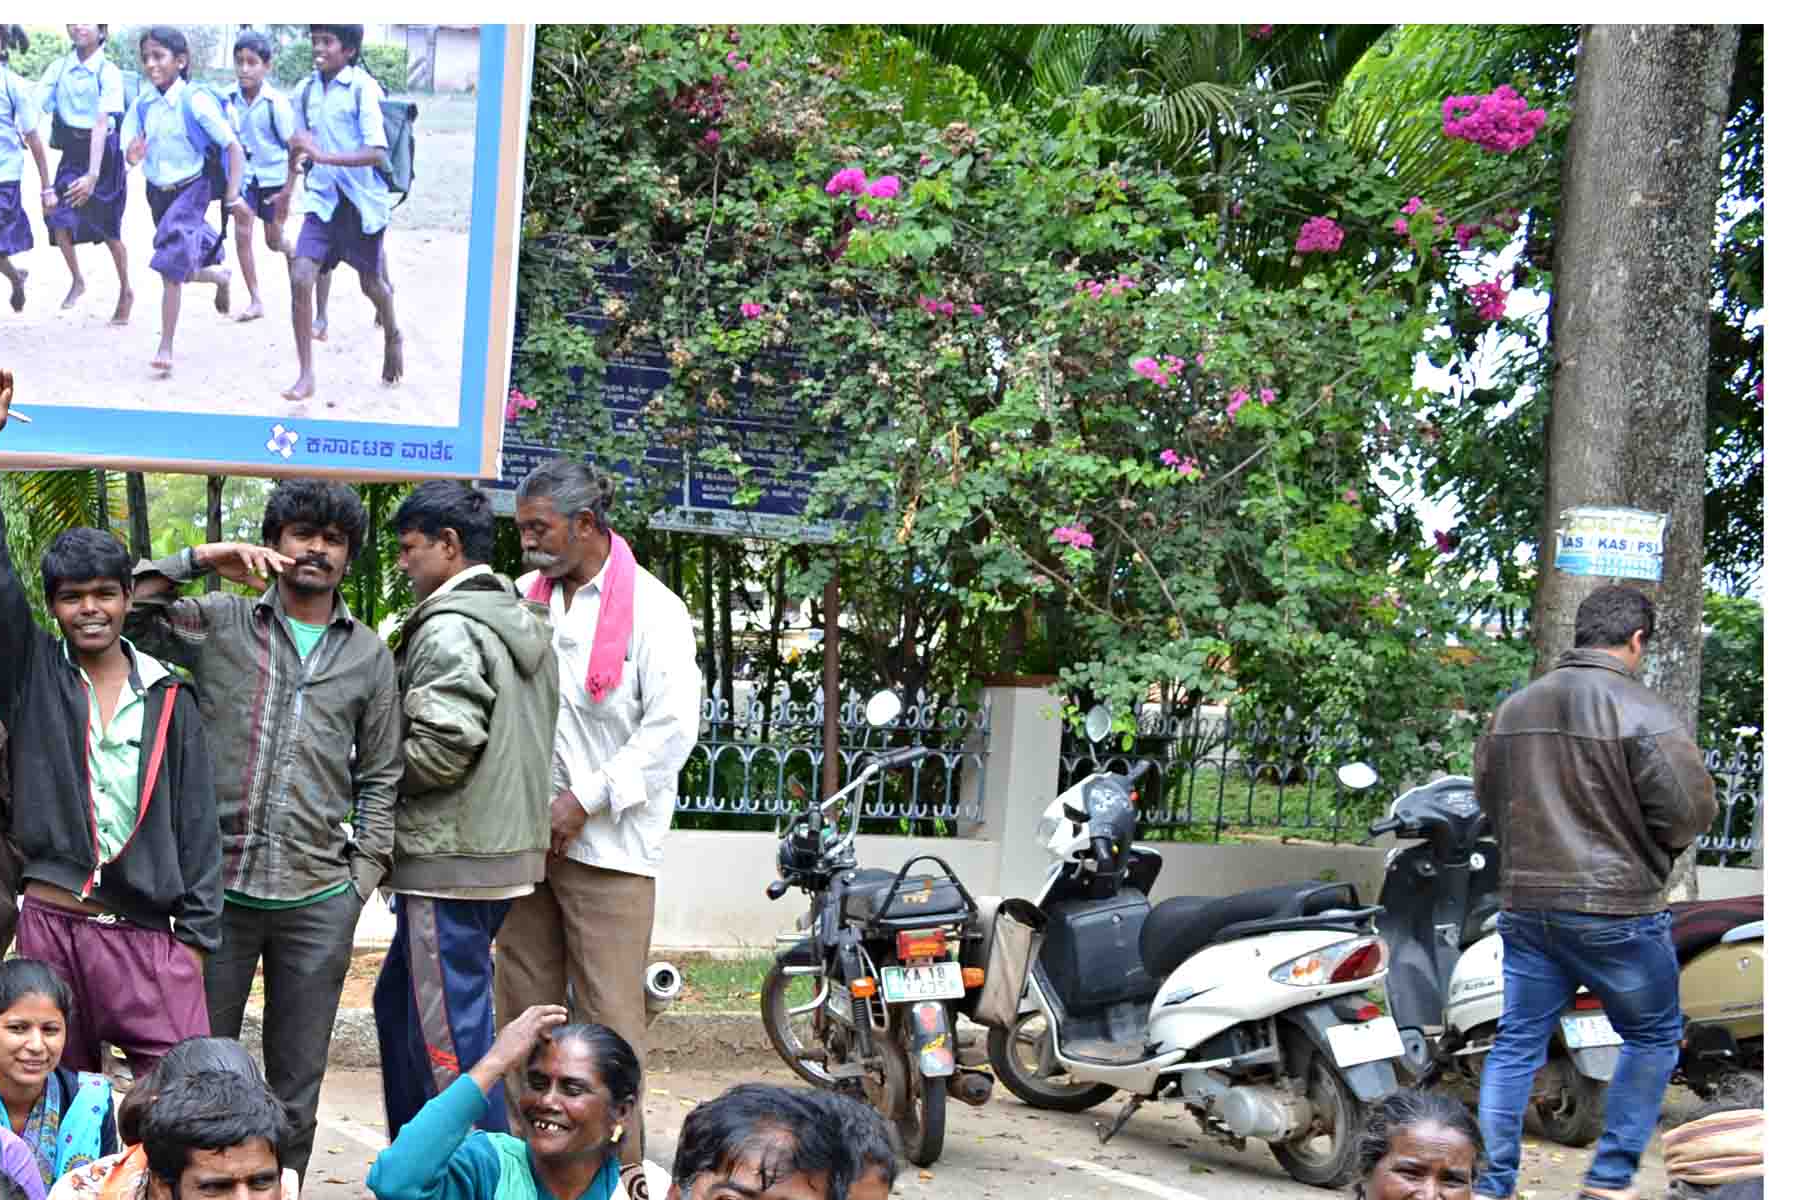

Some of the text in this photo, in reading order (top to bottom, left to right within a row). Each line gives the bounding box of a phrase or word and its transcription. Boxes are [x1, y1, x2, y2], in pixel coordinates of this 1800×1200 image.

[306, 437, 455, 462] ಕರ್ನಾಟಕ ವಾರ್ತೆ
[1598, 537, 1627, 551] KAS
